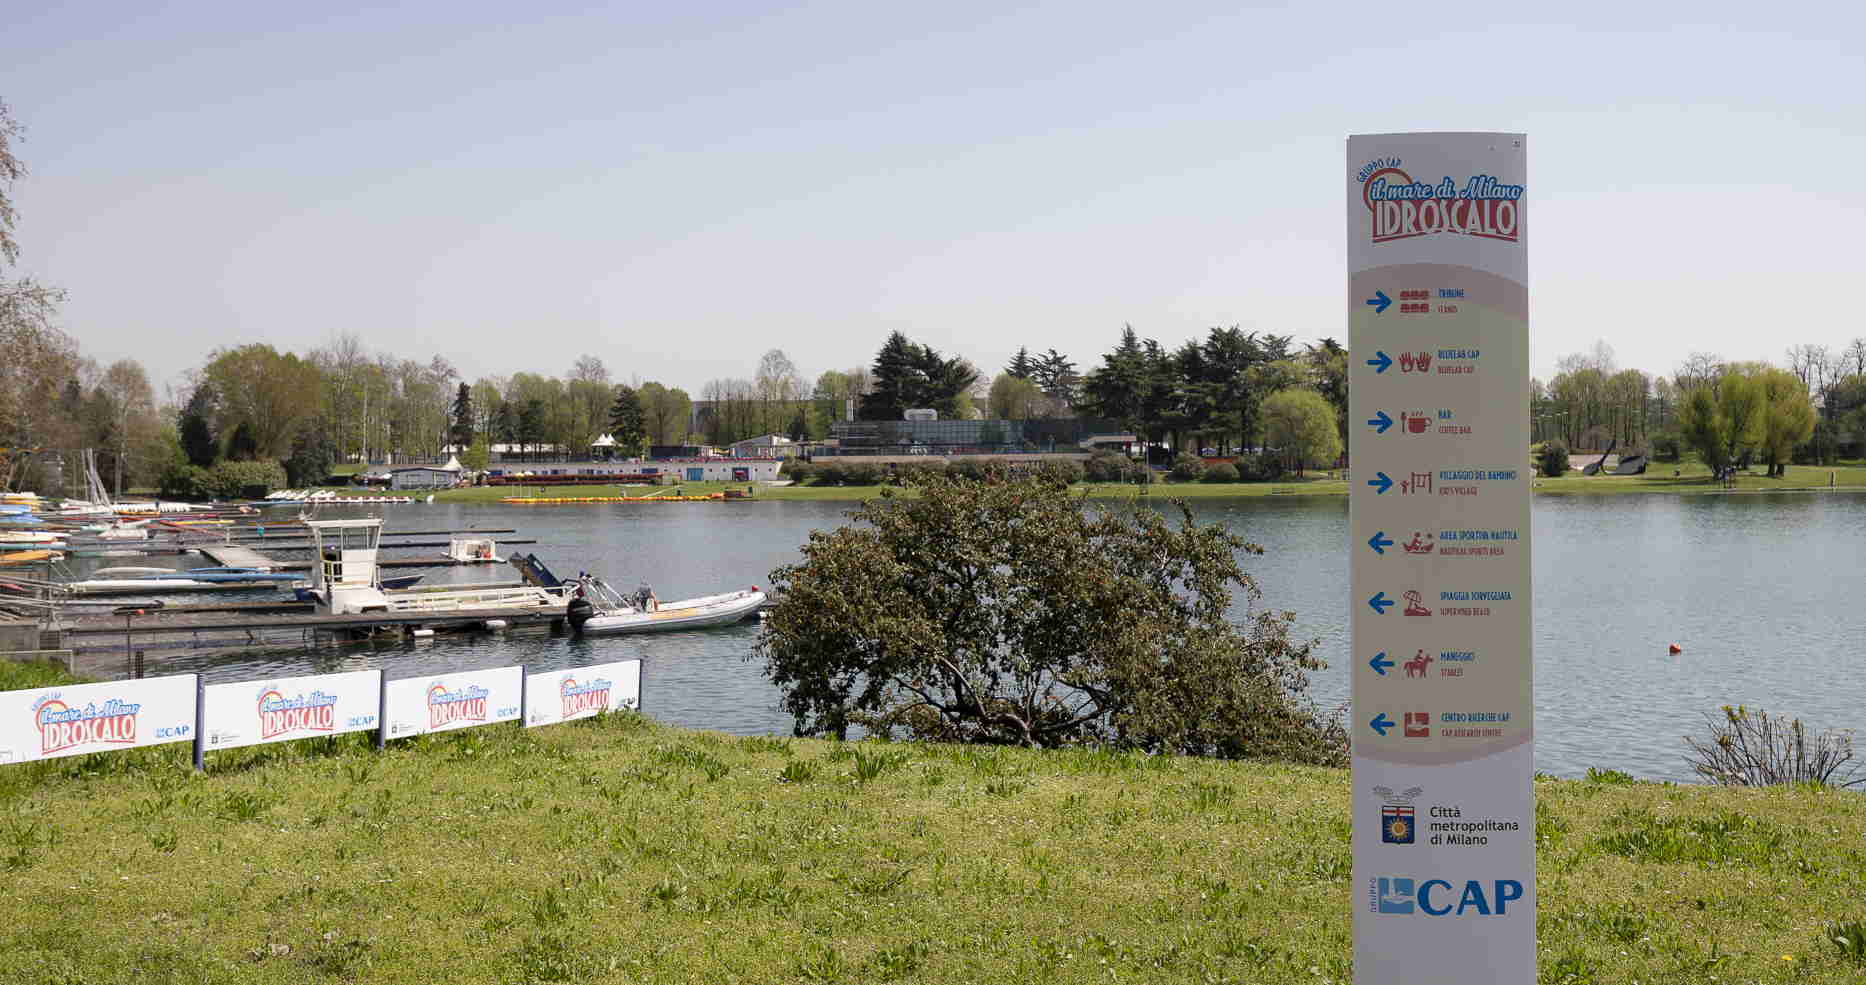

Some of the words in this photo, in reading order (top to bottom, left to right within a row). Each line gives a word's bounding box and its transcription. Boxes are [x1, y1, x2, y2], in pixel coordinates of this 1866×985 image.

[1356, 158, 1384, 183] GRUPPO
[1370, 177, 1387, 201] il
[1386, 184, 1434, 201] mare
[1435, 176, 1458, 201] di
[1460, 174, 1524, 201] Milano
[1375, 198, 1517, 236] IDROSCALO
[1467, 349, 1480, 360] CAP
[1438, 409, 1452, 419] BAR
[1440, 471, 1473, 481] VILLAGGIO
[1475, 471, 1487, 481] DEL
[1440, 530, 1457, 541] AREA
[1458, 530, 1488, 541] SPORTIVA
[1440, 591, 1470, 601] SPIAGGIA
[1440, 651, 1475, 662] MANEGGIO
[432, 699, 486, 728] IDROSCALO
[263, 705, 334, 737] IDROSCALO
[44, 714, 134, 750] IDROSCALO
[165, 725, 190, 738] CAP
[1430, 805, 1461, 819] Città
[1430, 819, 1519, 834] metropolitana
[1430, 834, 1442, 846] di
[1446, 834, 1488, 846] Milano
[1417, 879, 1523, 917] CAP
